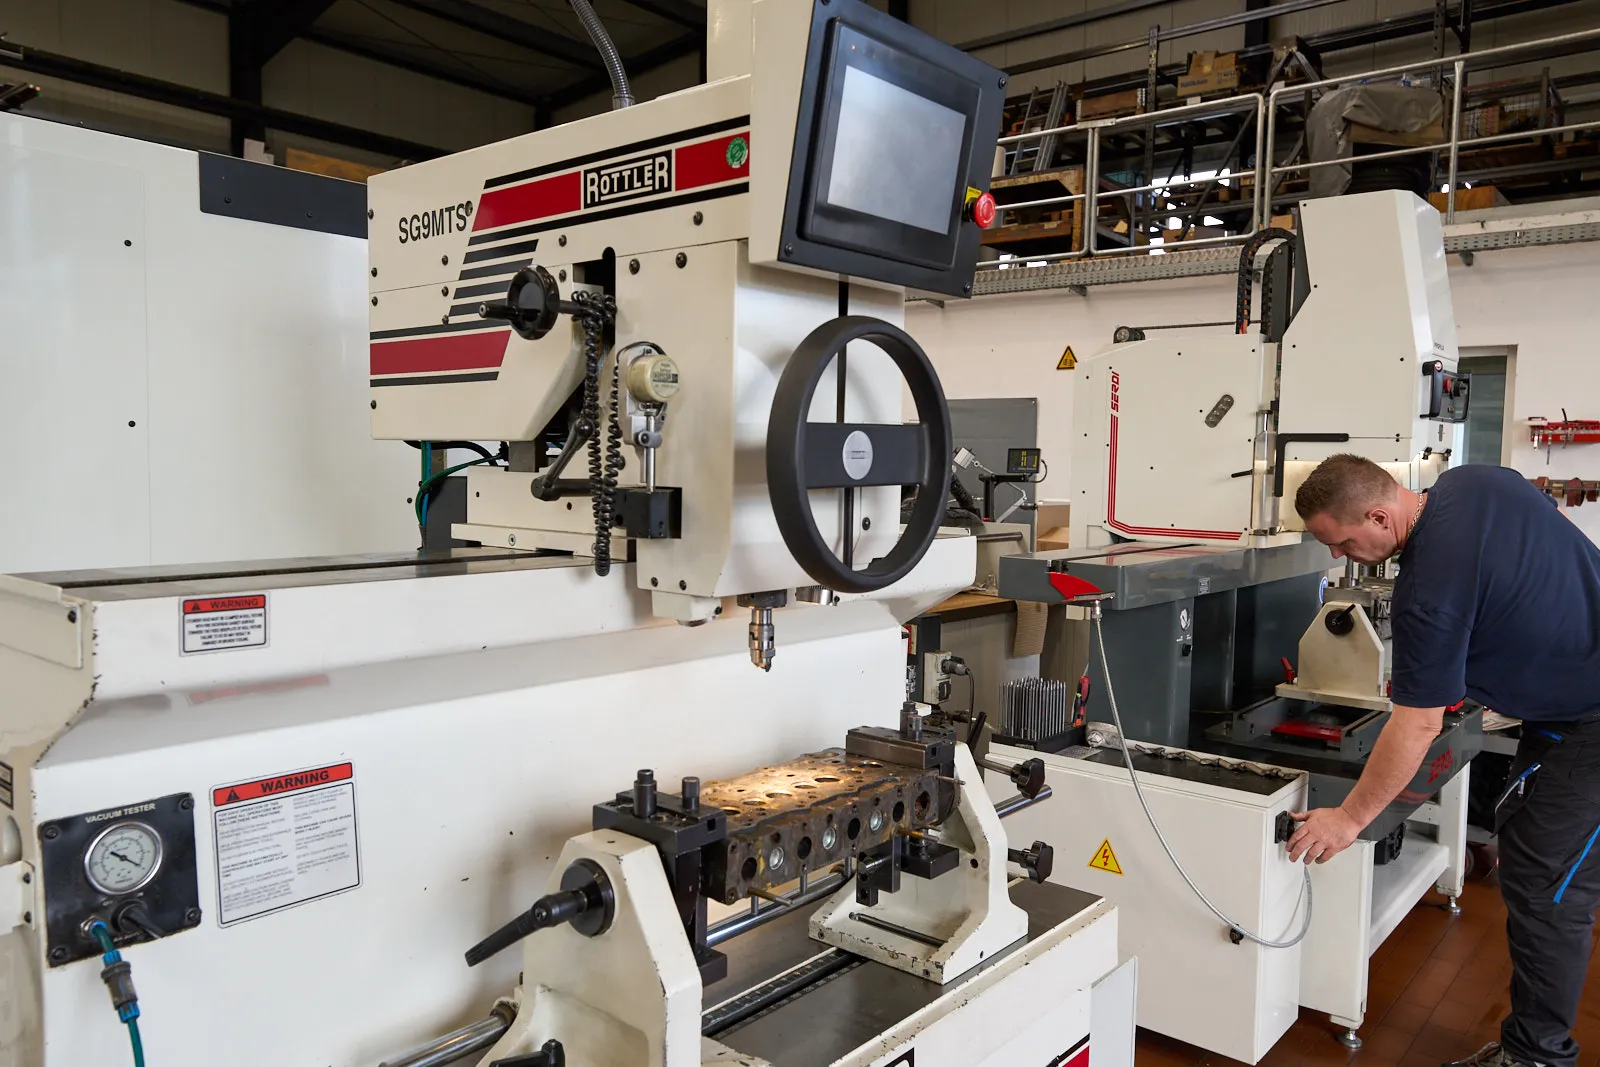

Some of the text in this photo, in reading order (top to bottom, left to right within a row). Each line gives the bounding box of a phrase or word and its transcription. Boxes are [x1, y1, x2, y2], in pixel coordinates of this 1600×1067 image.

[398, 203, 467, 244] SG9MTS
[1110, 370, 1120, 413] SERDI
[210, 598, 258, 609] WARNING
[261, 770, 329, 793] WARNING
[85, 803, 156, 823] VACUUM TESTER
